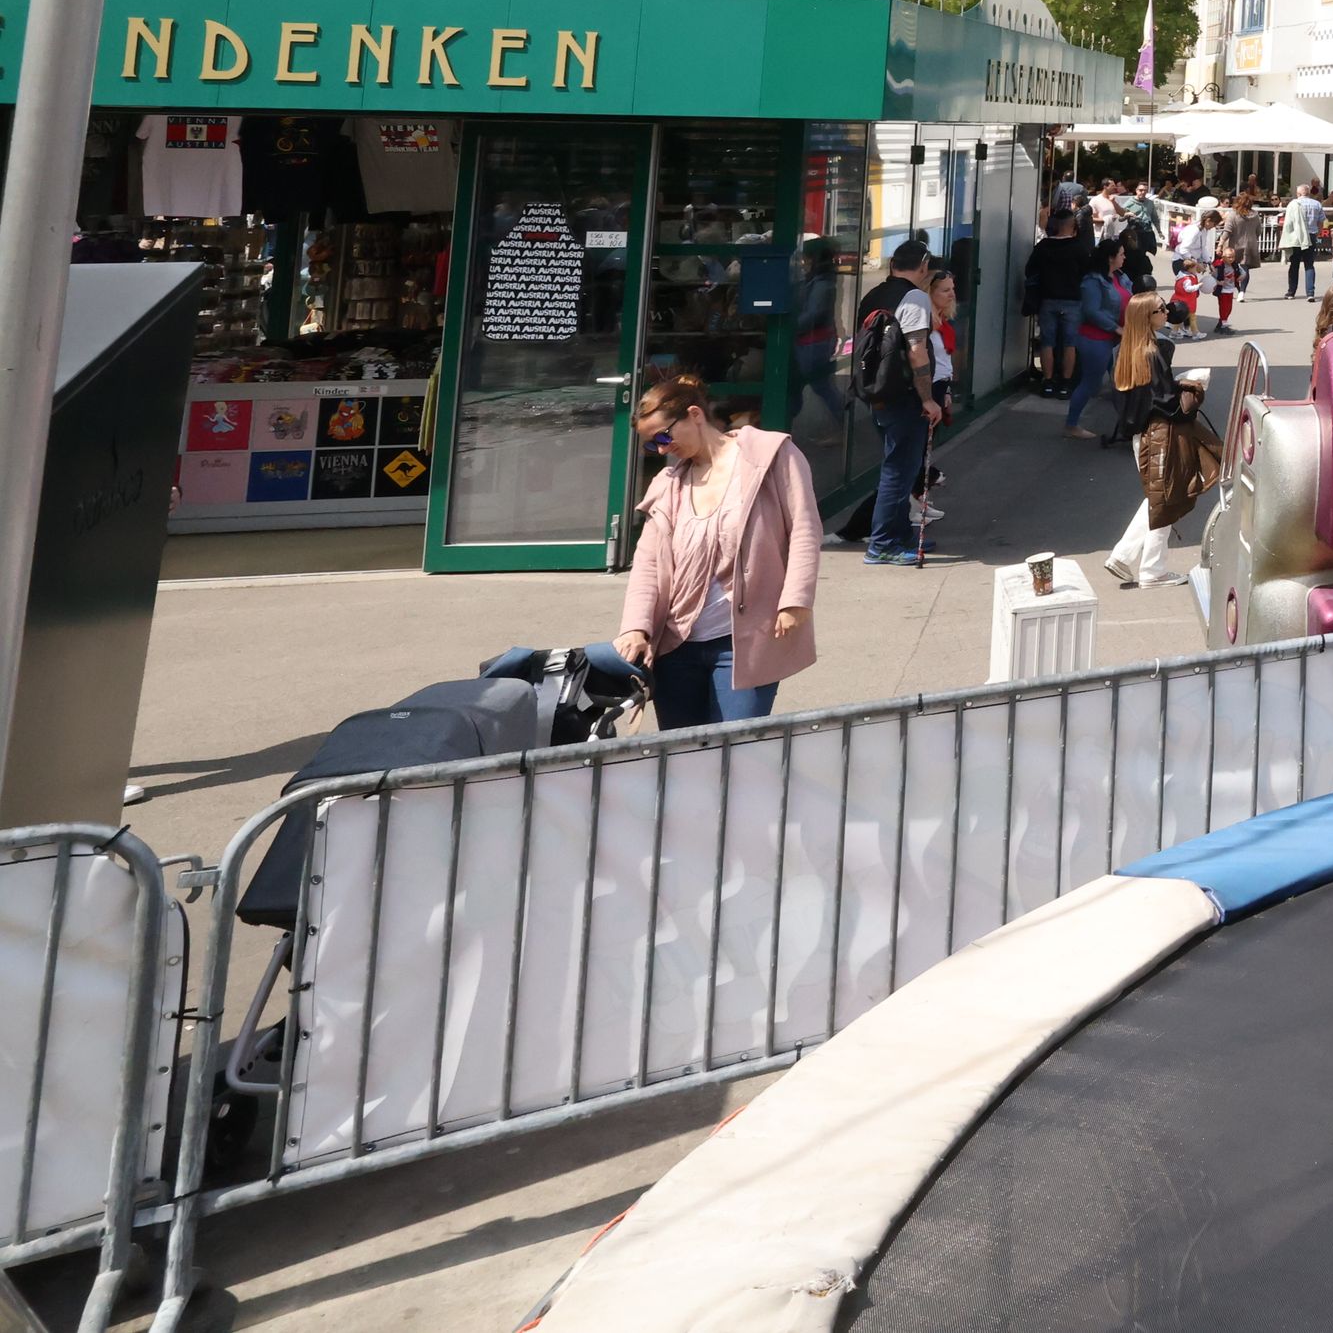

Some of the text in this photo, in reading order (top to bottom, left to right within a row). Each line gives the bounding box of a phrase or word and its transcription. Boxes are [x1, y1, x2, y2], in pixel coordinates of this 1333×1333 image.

[121, 17, 600, 90] NDENKEN
[380, 124, 435, 132] VIENNA
[314, 387, 349, 395] Kinder
[320, 454, 368, 468] VIENNA
